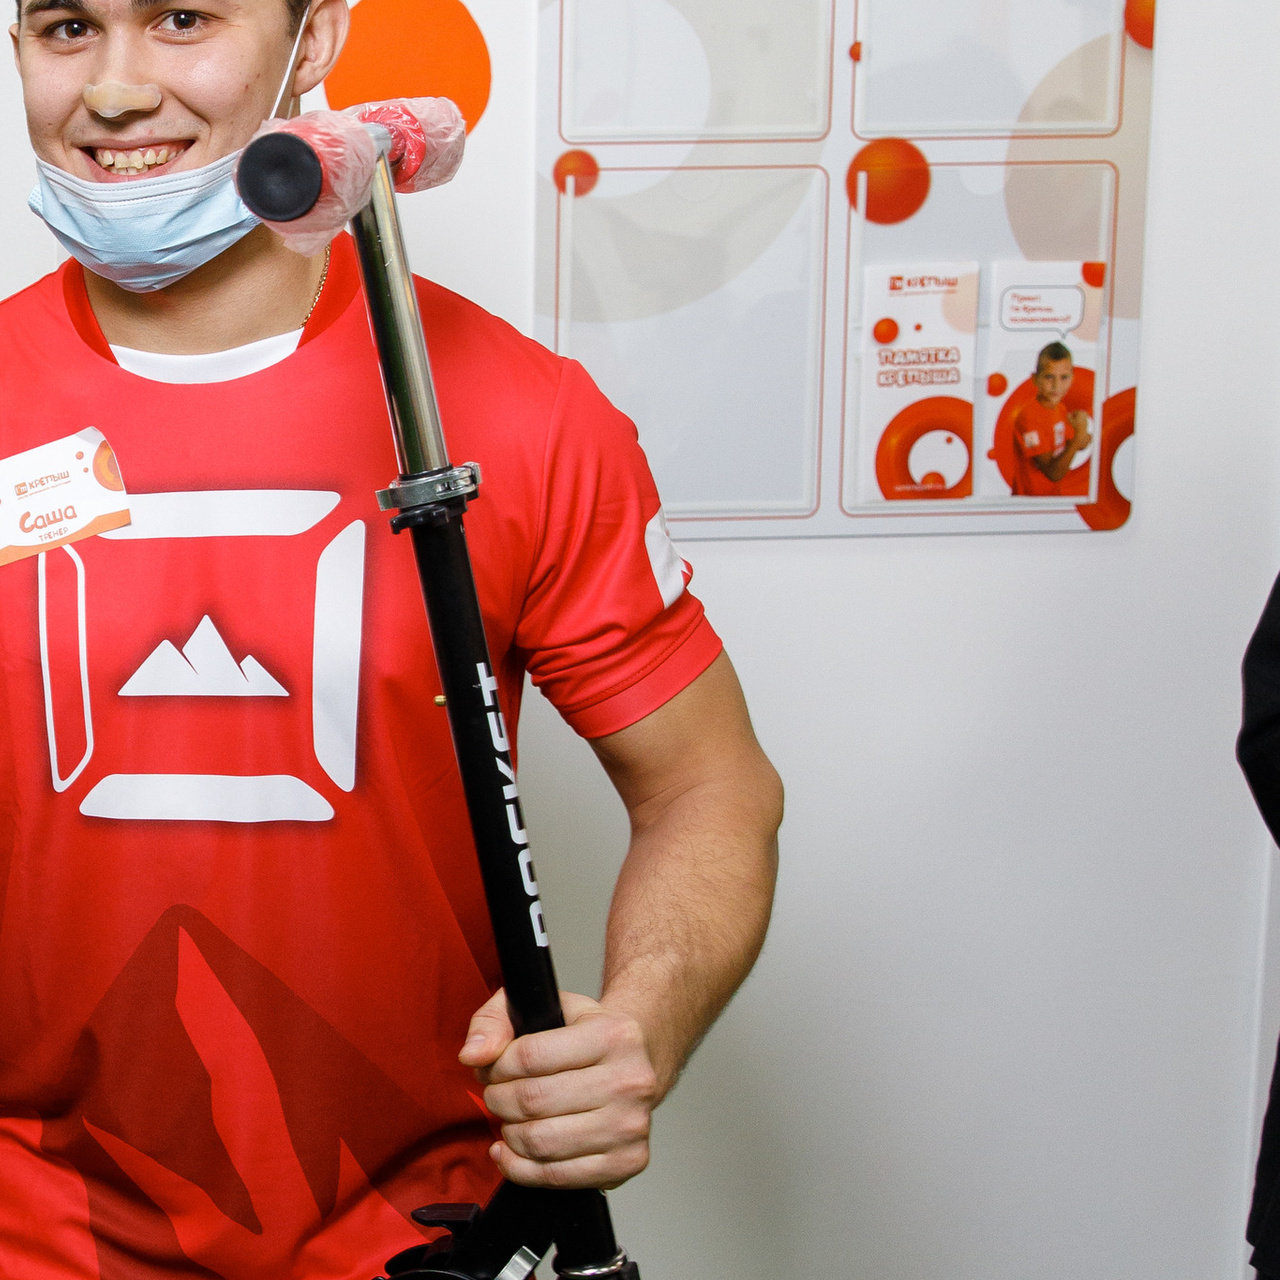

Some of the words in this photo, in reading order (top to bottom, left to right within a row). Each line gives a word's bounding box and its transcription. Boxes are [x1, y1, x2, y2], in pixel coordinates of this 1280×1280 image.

[877, 347, 961, 366] ПАМЯТКА
[28, 470, 70, 490] КРЕПЫШ
[19, 505, 77, 533] Саша
[38, 526, 69, 542] ТРЕНЕР
